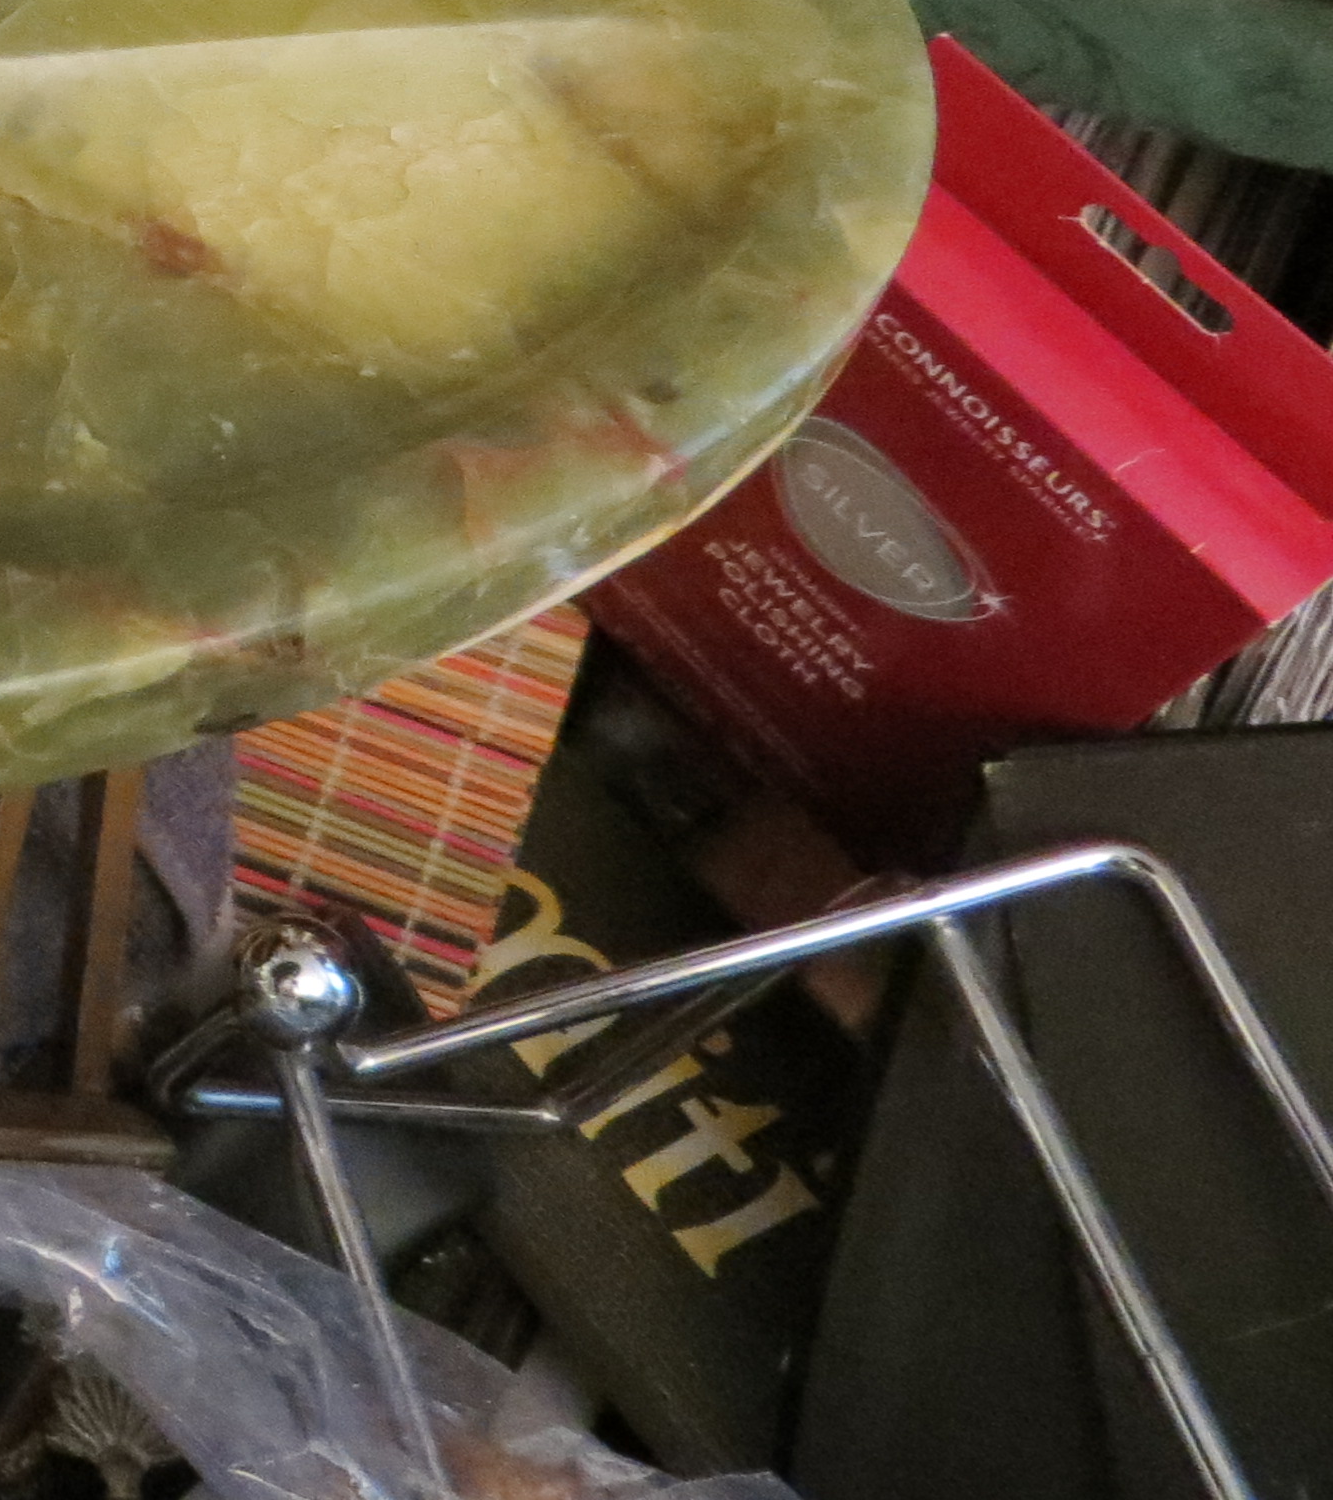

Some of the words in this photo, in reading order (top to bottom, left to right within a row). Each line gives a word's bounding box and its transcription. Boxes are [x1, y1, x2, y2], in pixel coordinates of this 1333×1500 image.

[875, 313, 1107, 529] CONNOISSEURS
[803, 463, 934, 594] SILVER
[704, 542, 865, 699] POLISHING
[718, 587, 817, 685] CLOTH
[728, 542, 874, 670] JEWELRY
